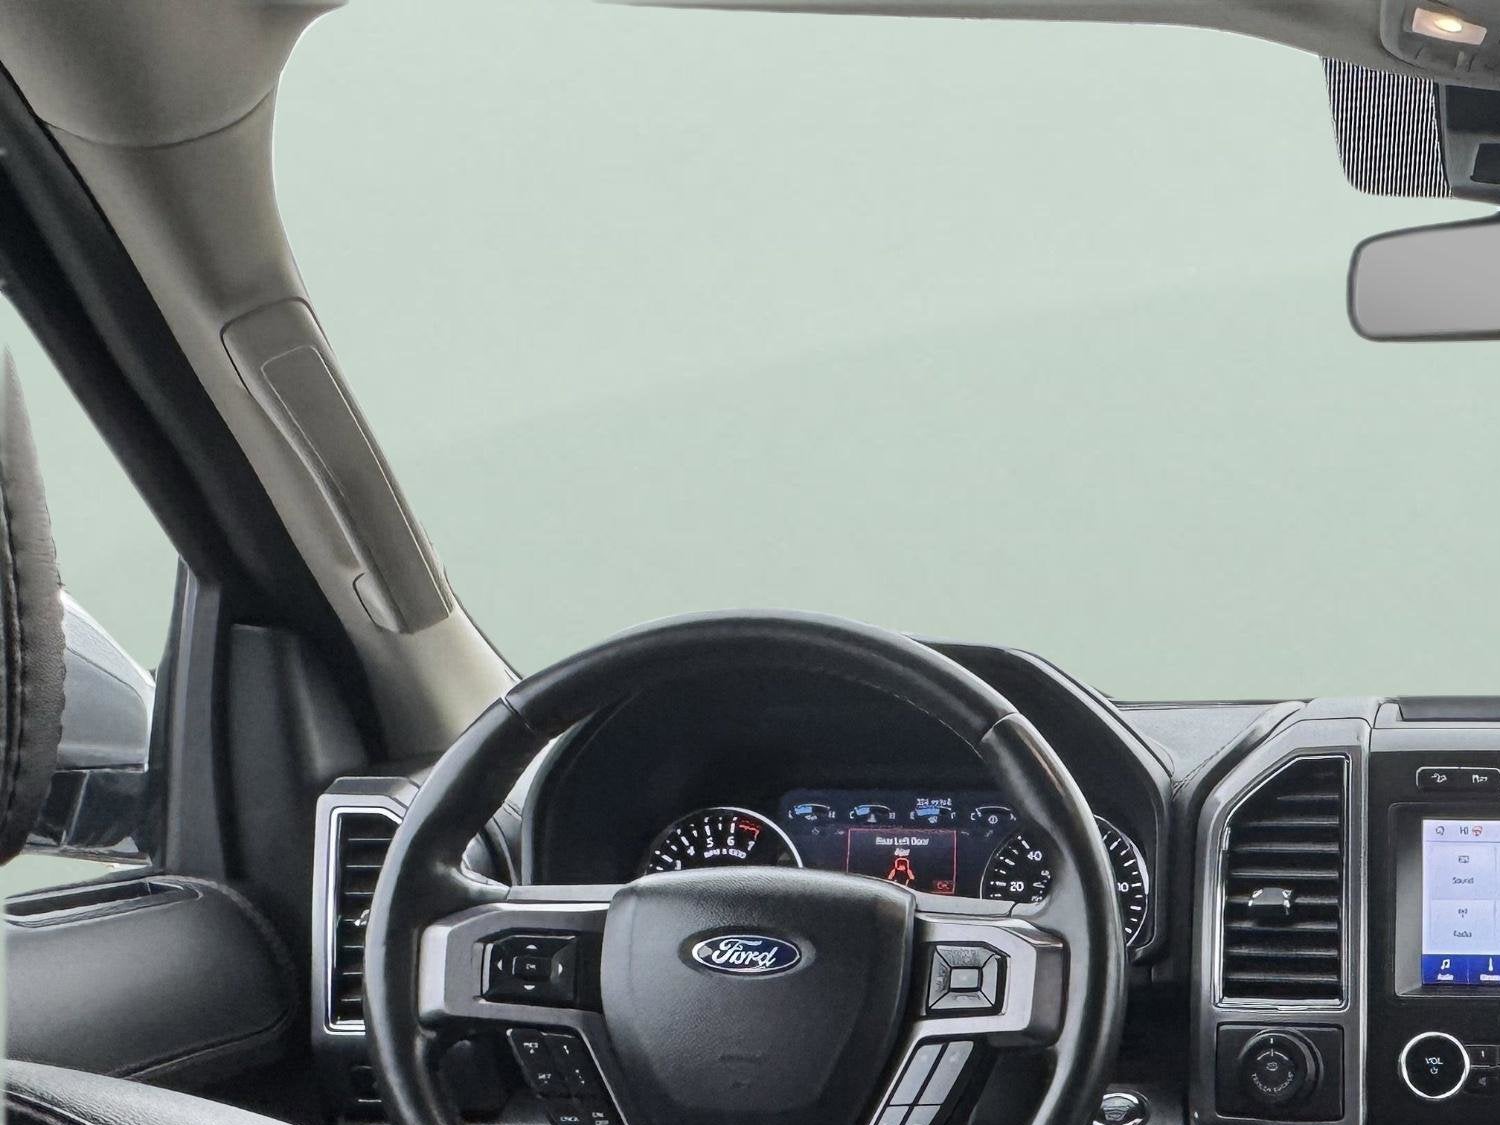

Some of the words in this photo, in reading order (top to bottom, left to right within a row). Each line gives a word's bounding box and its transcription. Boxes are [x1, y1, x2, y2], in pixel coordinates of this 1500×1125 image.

[706, 837, 714, 848] 5
[727, 836, 735, 847] 6
[894, 837, 910, 846] Left
[911, 837, 930, 846] Door
[1027, 850, 1042, 862] 40
[1009, 881, 1025, 892] 20
[711, 938, 779, 970] Ford
[1425, 1057, 1443, 1065] VOL
